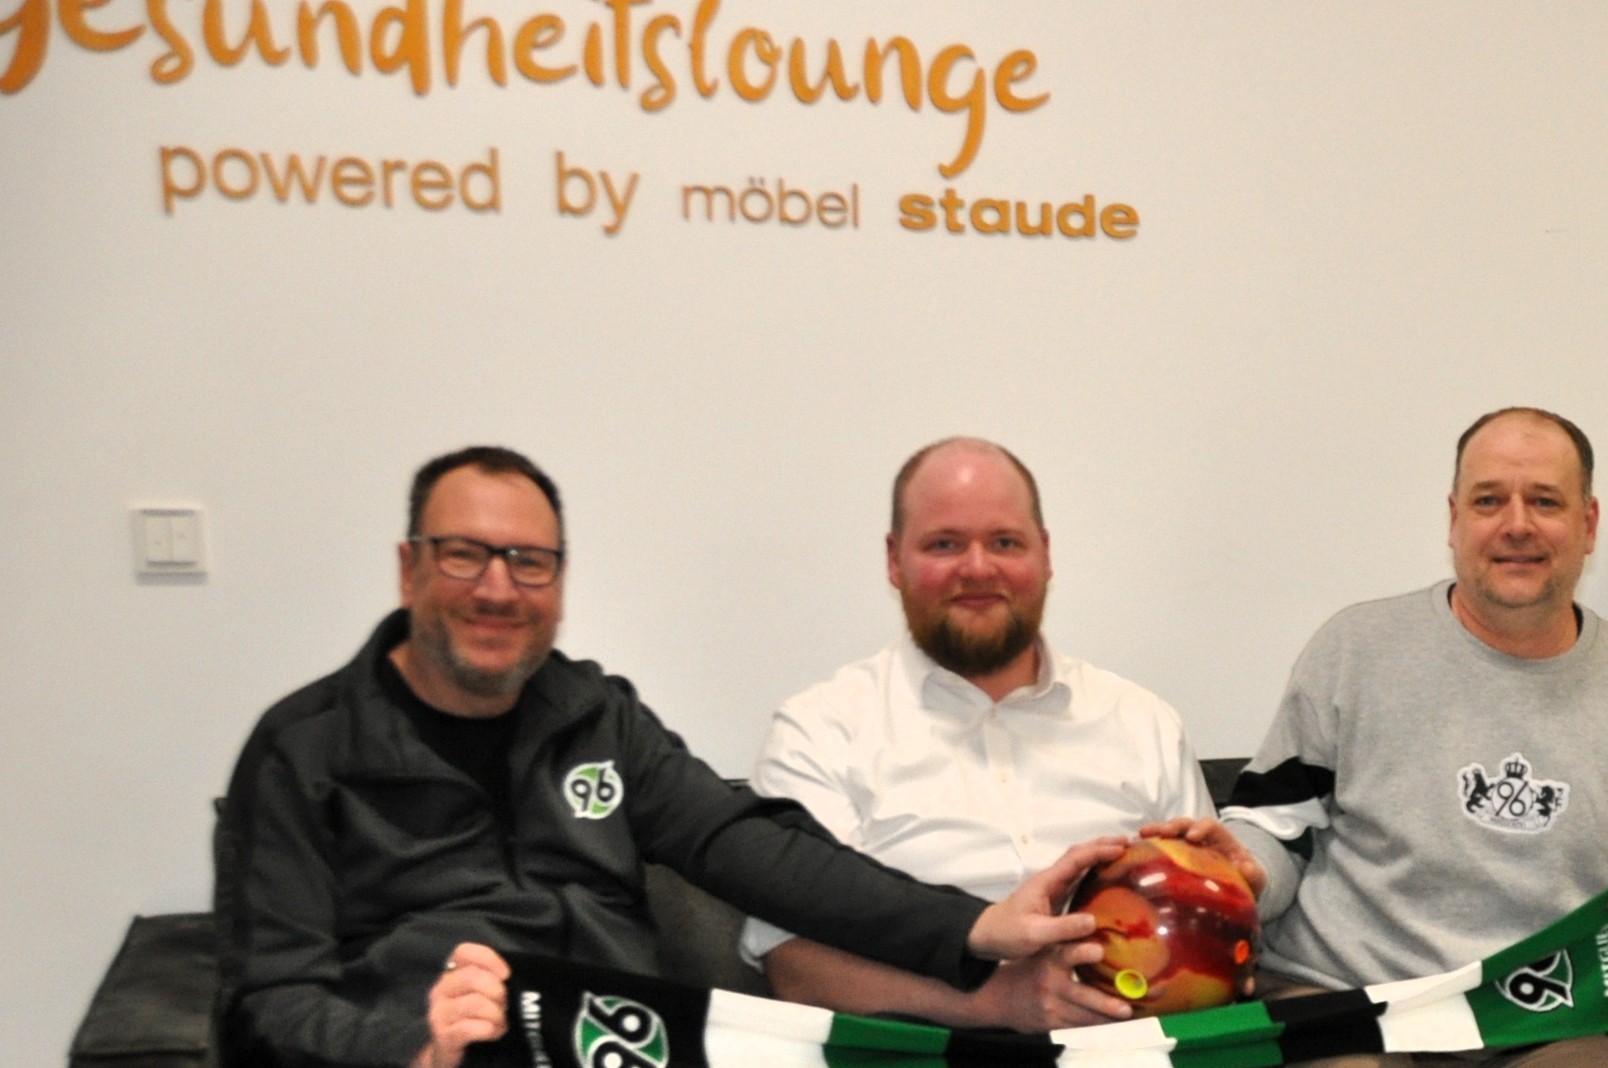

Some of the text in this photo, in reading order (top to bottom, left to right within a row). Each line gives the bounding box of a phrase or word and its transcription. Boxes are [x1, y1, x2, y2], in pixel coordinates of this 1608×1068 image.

[160, 145, 1142, 241] powered by möbel staude
[565, 761, 622, 818] 96
[1496, 780, 1529, 818] 96
